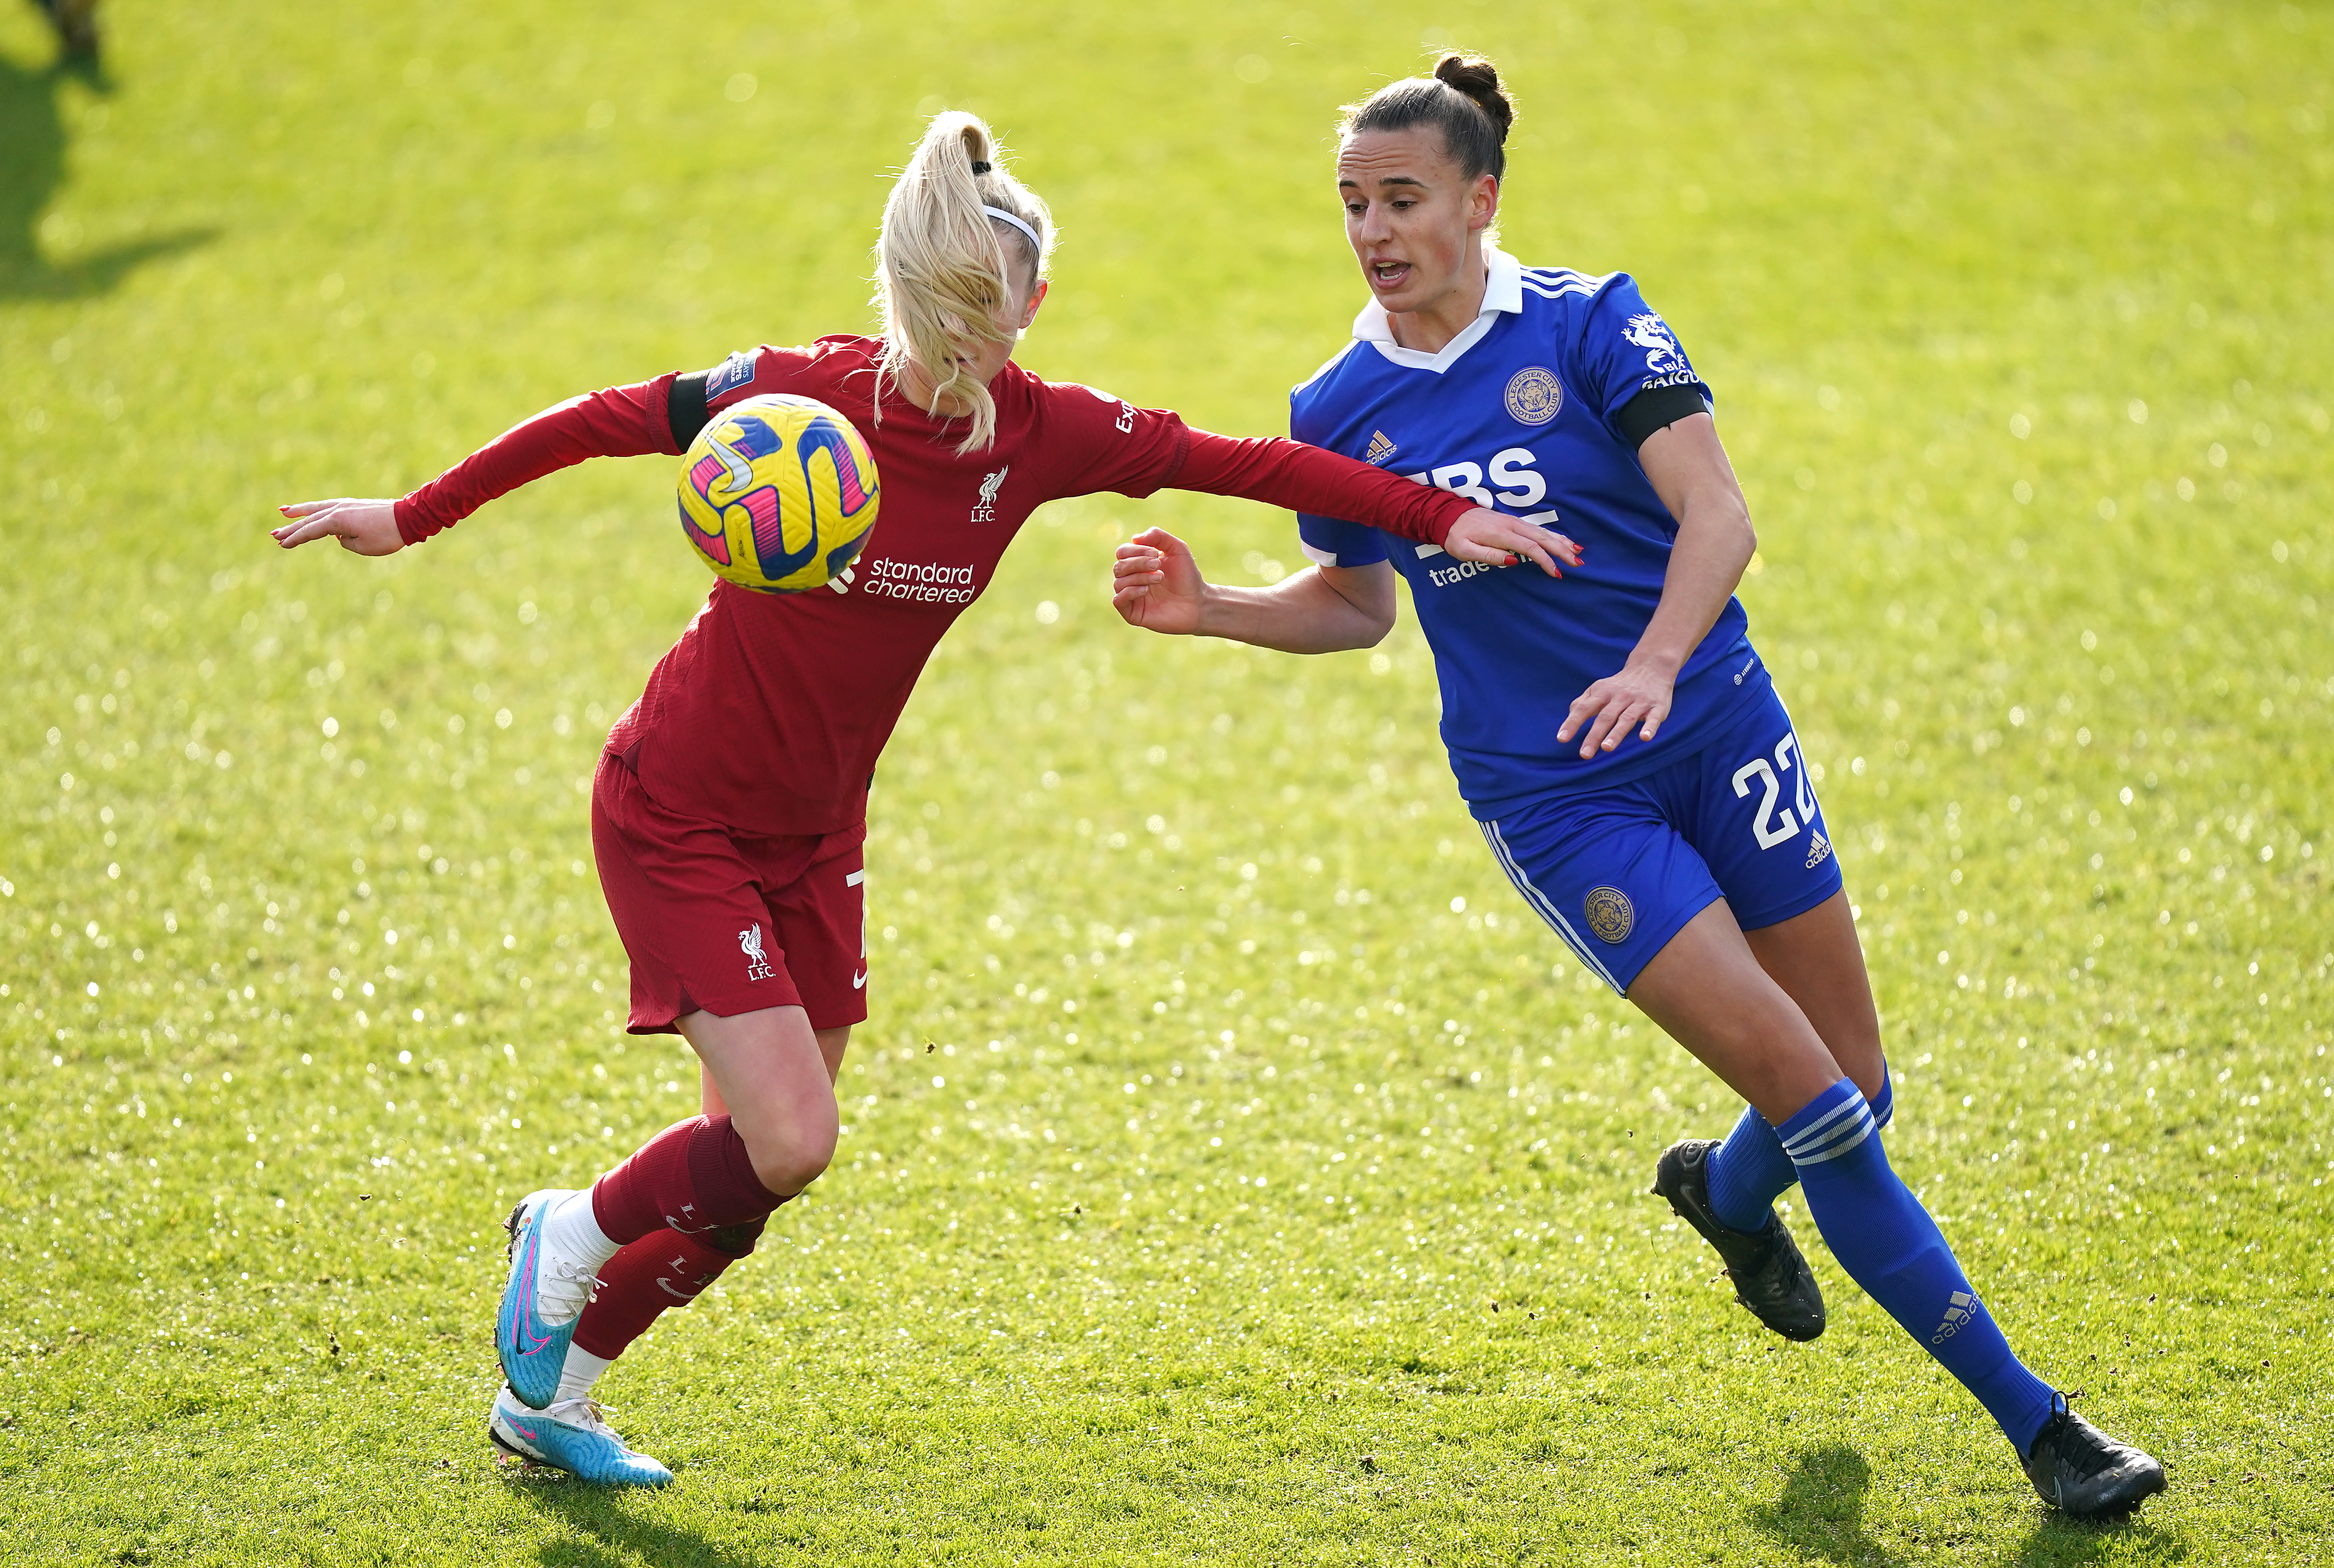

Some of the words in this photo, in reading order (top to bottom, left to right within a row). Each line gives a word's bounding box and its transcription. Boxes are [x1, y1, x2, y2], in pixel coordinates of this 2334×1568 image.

[1663, 361, 1686, 372] BIA
[1510, 372, 1542, 398] LEICESTER
[1542, 375, 1556, 389] CITY
[1511, 402, 1549, 419] FOOTBALL
[1547, 393, 1558, 412] CLUB
[1402, 447, 1547, 509] BS
[871, 557, 974, 584] standard
[863, 578, 975, 603] chartered
[1732, 732, 1816, 851] 22
[1805, 842, 1831, 869] adida
[1588, 893, 1603, 927] LEICESTER
[1604, 892, 1621, 902] CITY
[1599, 924, 1628, 939] FOOTBALL
[1620, 903, 1629, 923] CLUB
[1931, 1291, 1979, 1344] adidas
